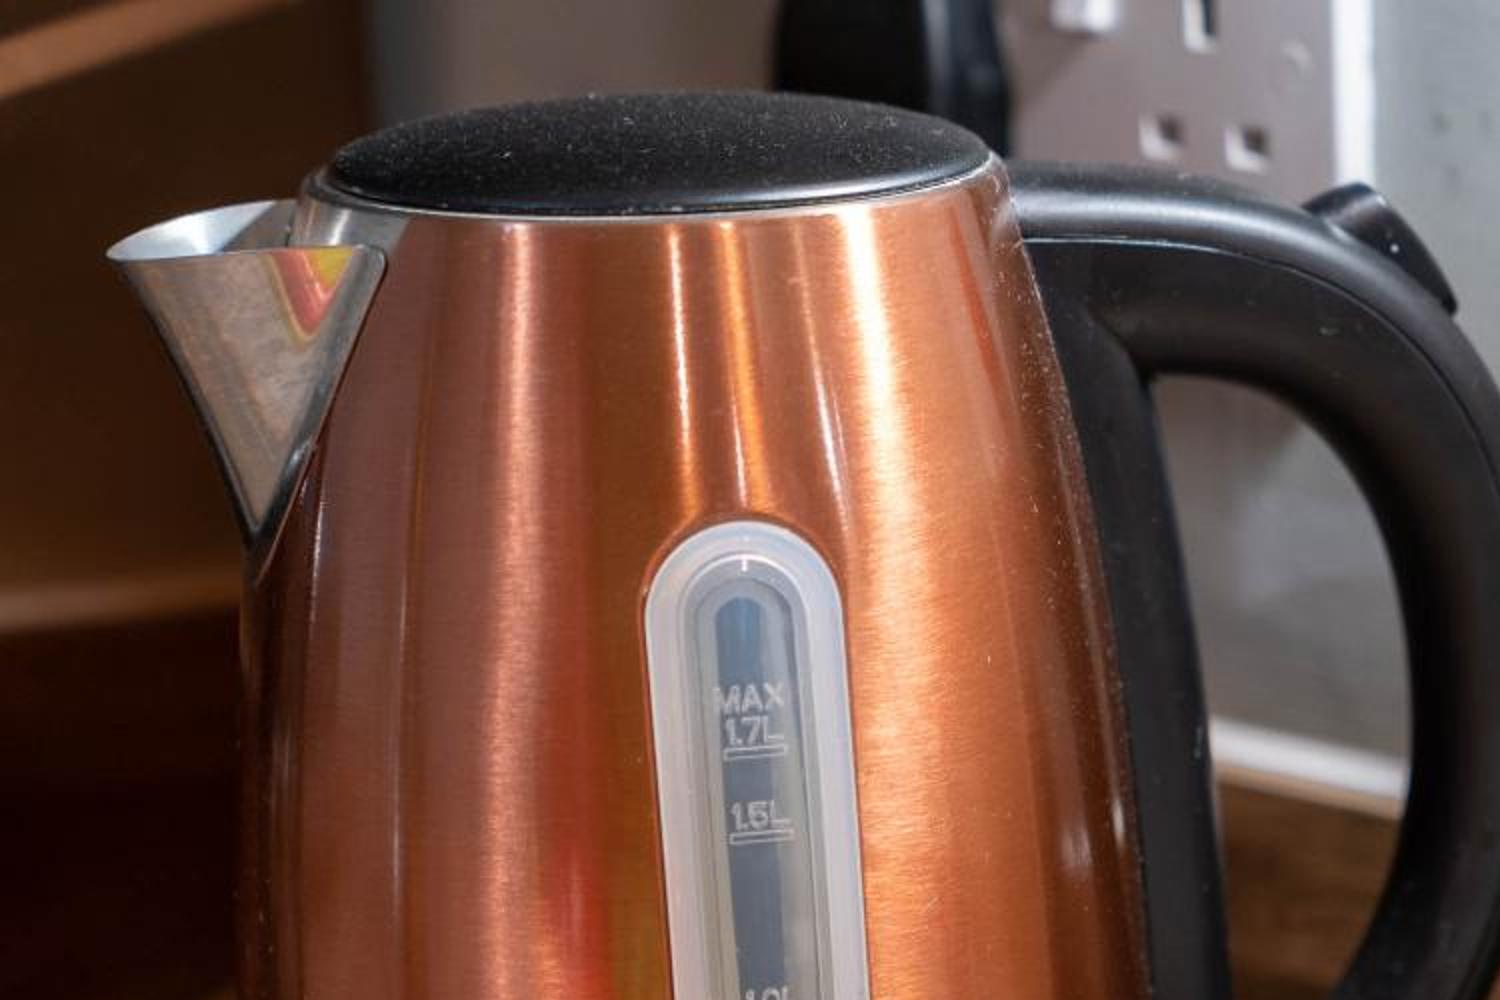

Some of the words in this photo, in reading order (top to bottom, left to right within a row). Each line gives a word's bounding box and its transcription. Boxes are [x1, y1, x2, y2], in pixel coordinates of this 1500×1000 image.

[712, 682, 784, 715] MAX
[725, 716, 785, 745] 1.7L
[731, 800, 792, 831] 1.5L
